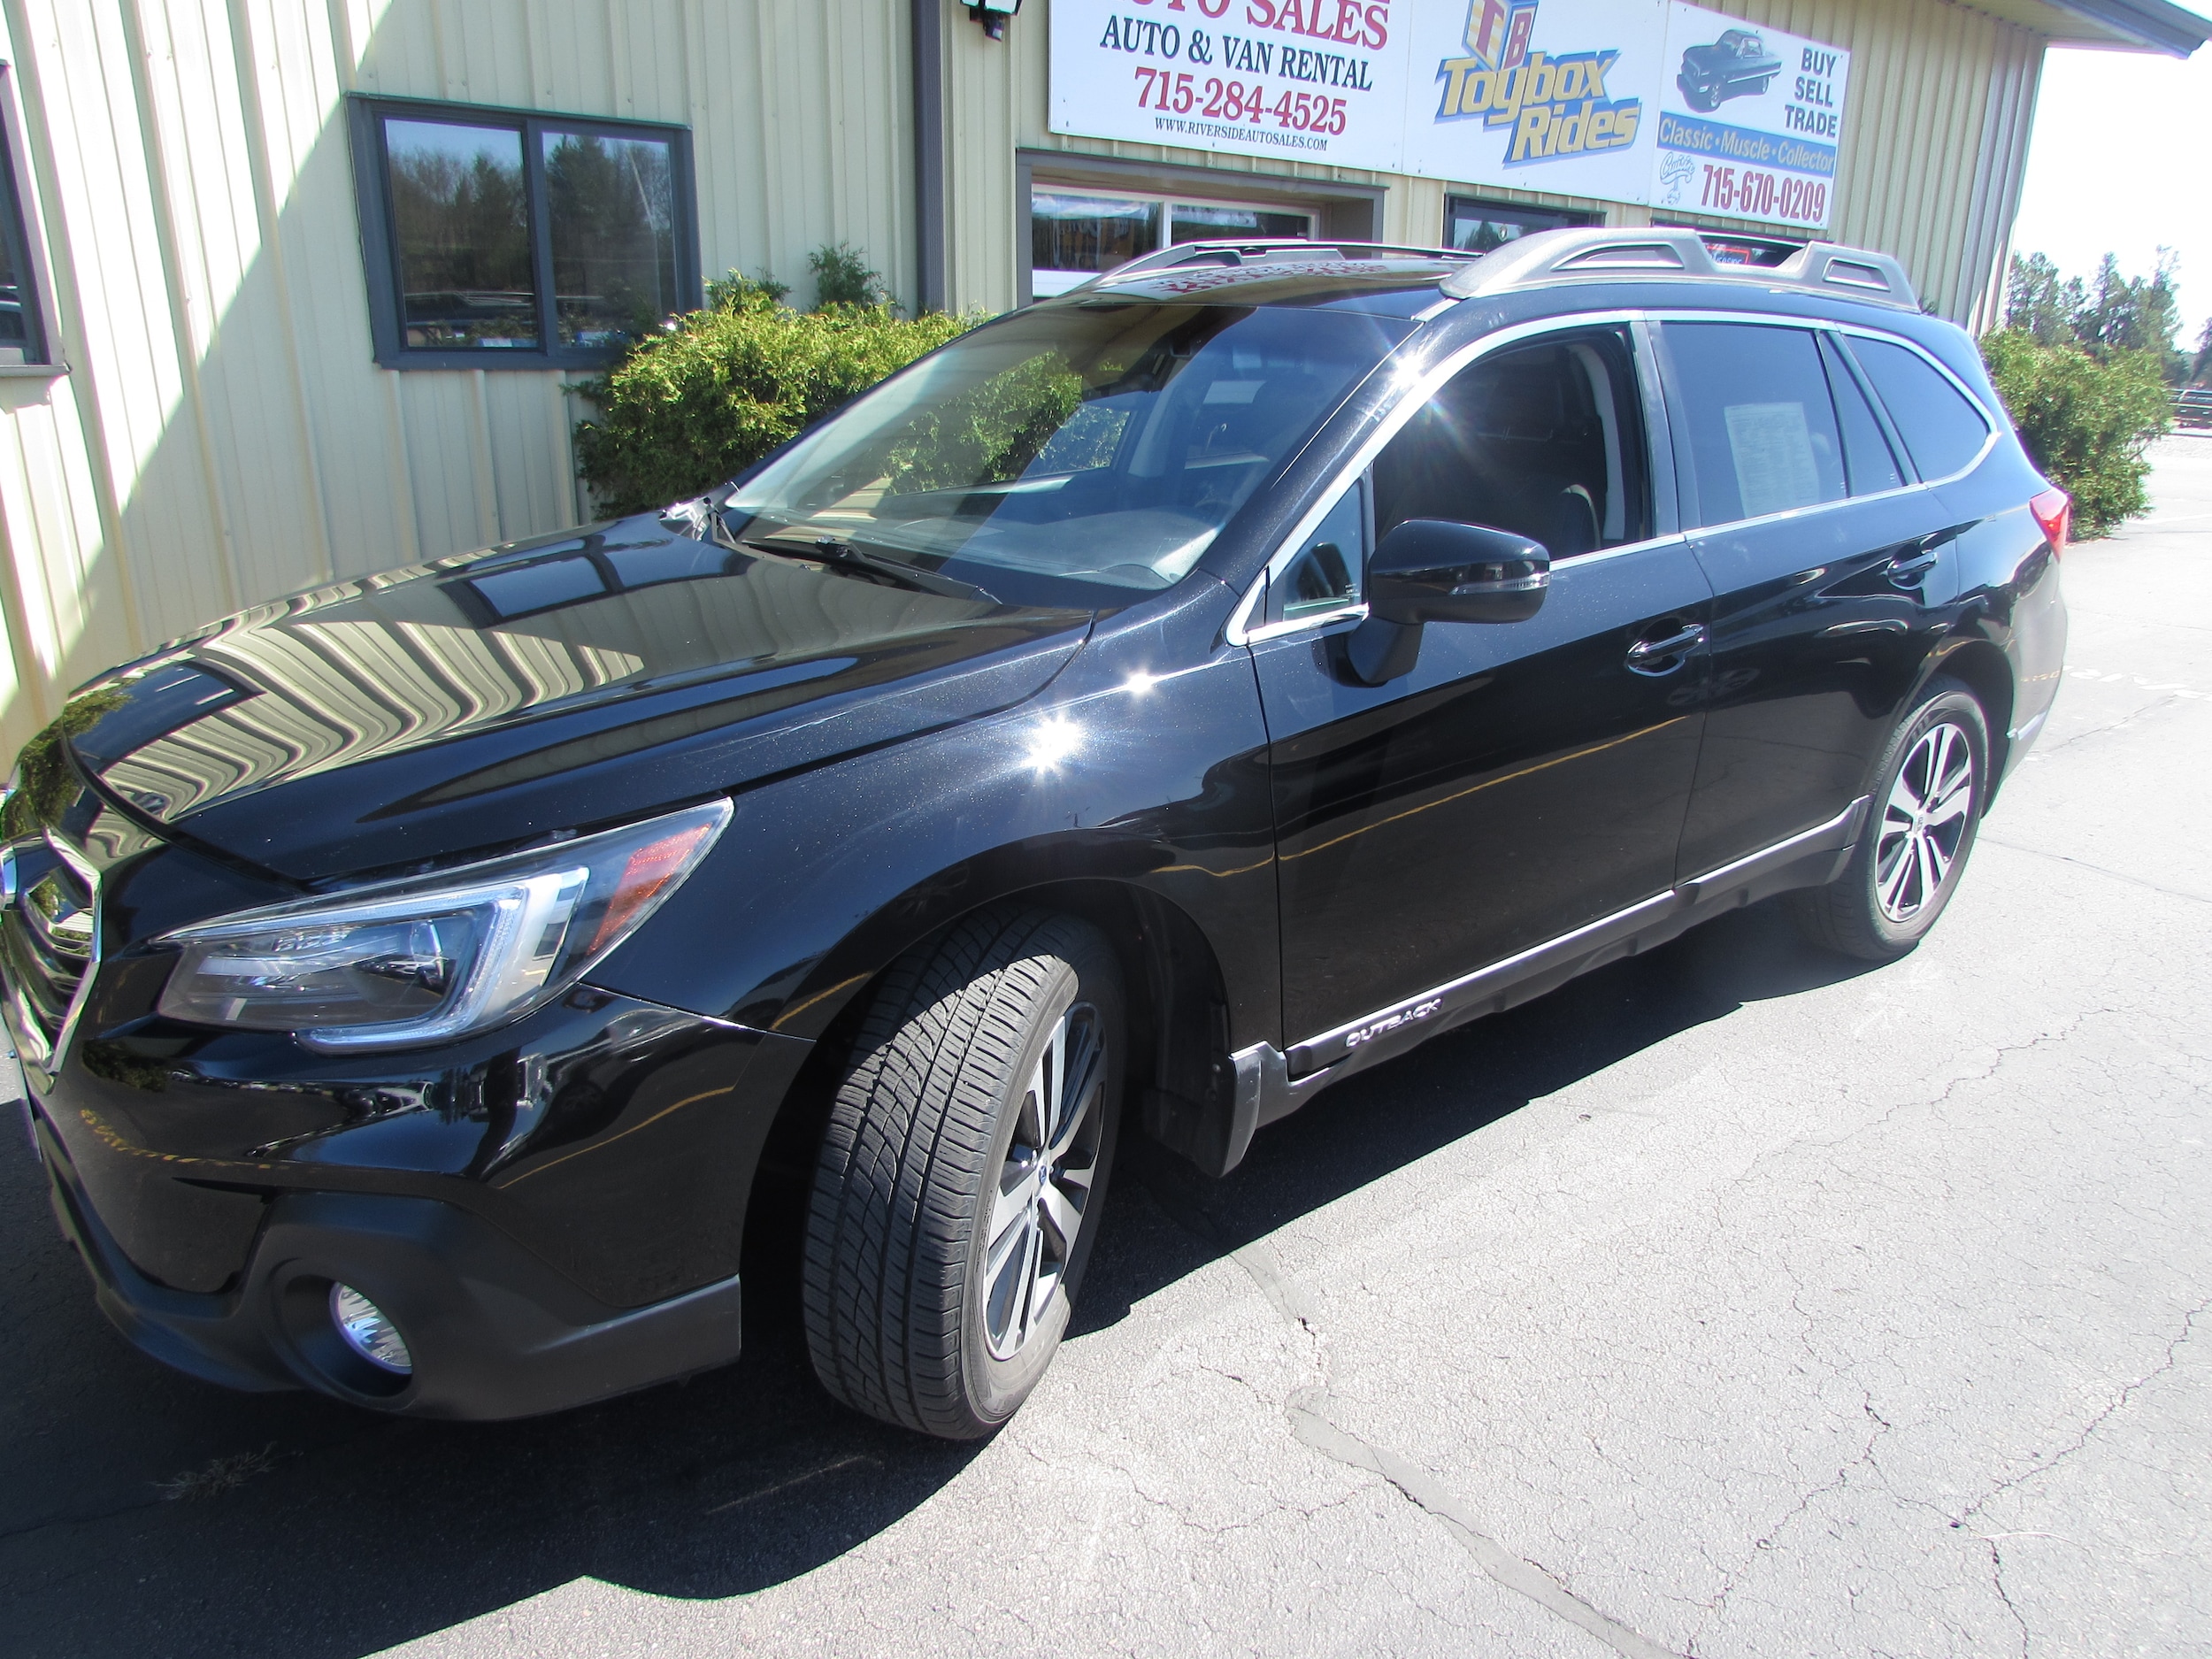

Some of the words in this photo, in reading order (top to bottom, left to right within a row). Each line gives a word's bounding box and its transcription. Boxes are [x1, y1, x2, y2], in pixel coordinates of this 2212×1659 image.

[1247, 0, 1388, 50] SALES
[1099, 14, 1180, 59] AUTO
[1188, 29, 1213, 65] &
[1223, 35, 1273, 74] VAN
[1279, 45, 1372, 92] RENTAL
[1801, 48, 1837, 78] BUY
[1134, 66, 1347, 135] 715-284-4525
[1438, 51, 1616, 127] Toybox
[1794, 76, 1833, 108] SELL
[1155, 117, 1328, 151] WWW.RIVERSIDEAUTOSALES.COM
[1507, 100, 1641, 165] Rides
[1660, 119, 1713, 150] Classic
[1720, 129, 1770, 161] Muscle
[1778, 141, 1834, 172] Collector
[1785, 104, 1838, 138] TRADE
[1701, 165, 1825, 222] 715-670-0209
[1345, 997, 1442, 1048] OUTBACK
